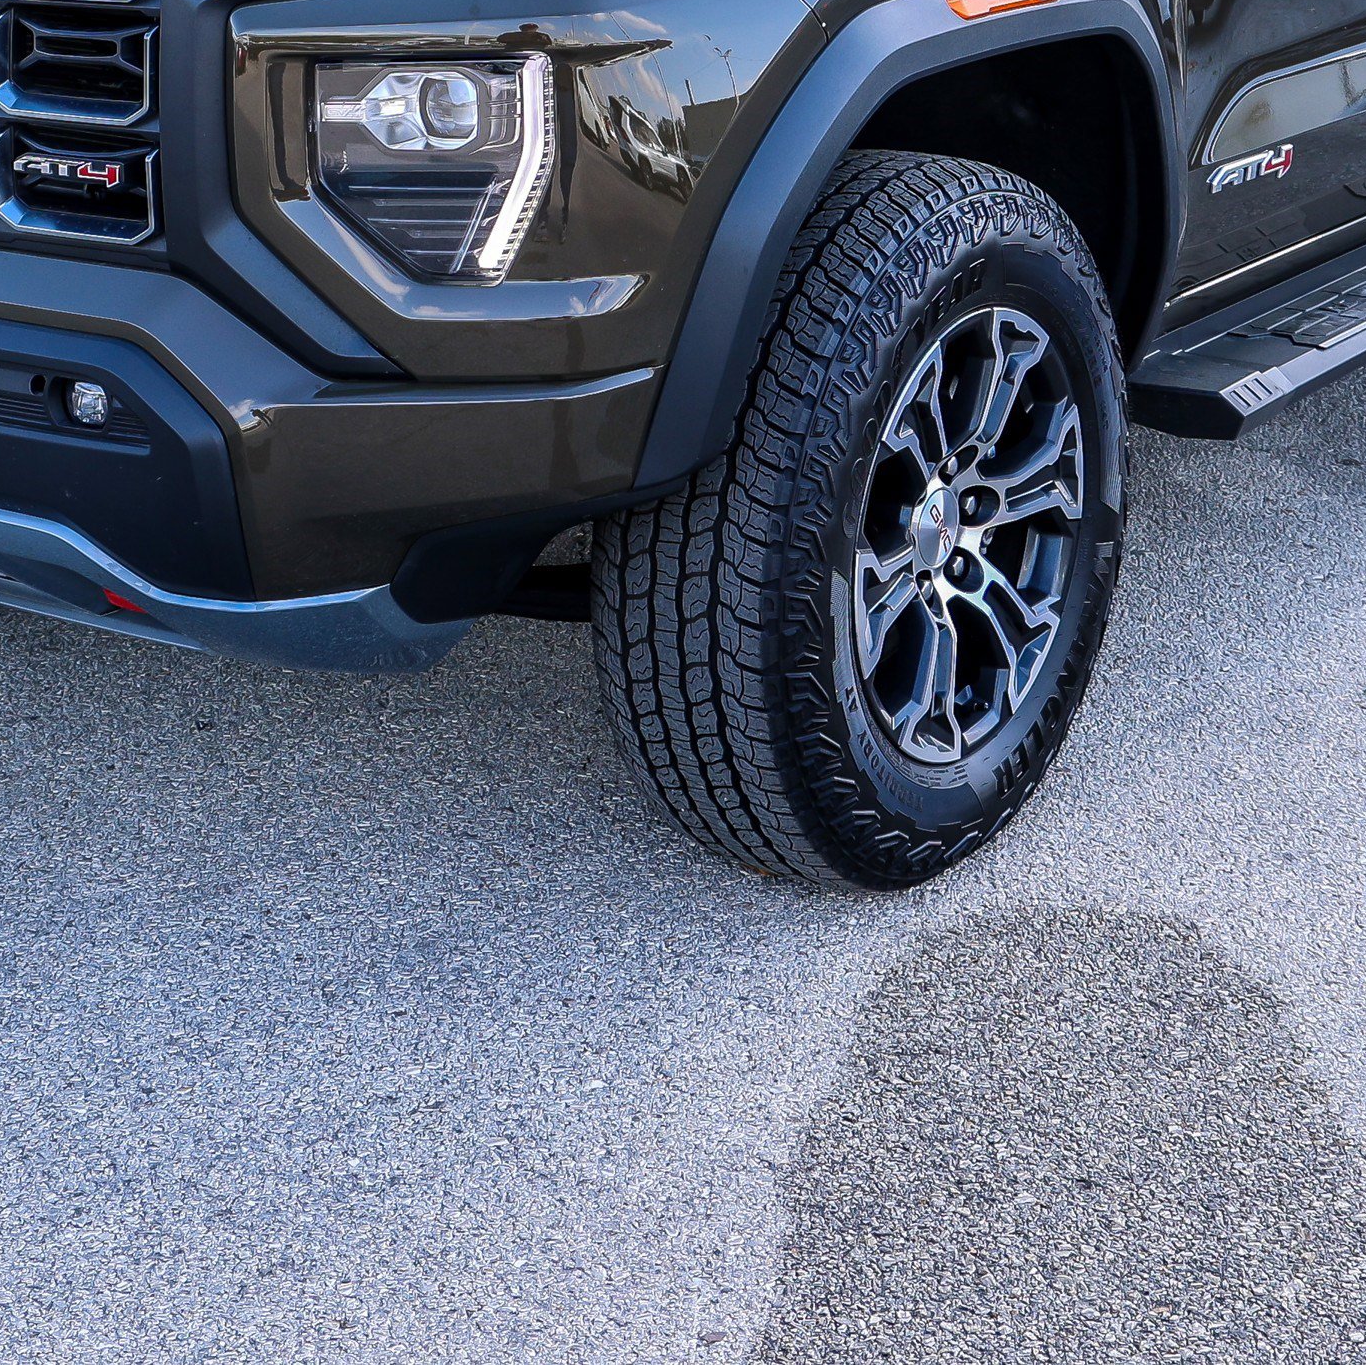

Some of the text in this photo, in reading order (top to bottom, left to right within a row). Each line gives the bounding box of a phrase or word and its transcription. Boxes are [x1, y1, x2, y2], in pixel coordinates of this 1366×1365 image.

[13, 154, 122, 188] AT4
[1206, 143, 1294, 194] AT4
[930, 504, 952, 553] GMC
[992, 541, 1115, 801] WRANGLER
